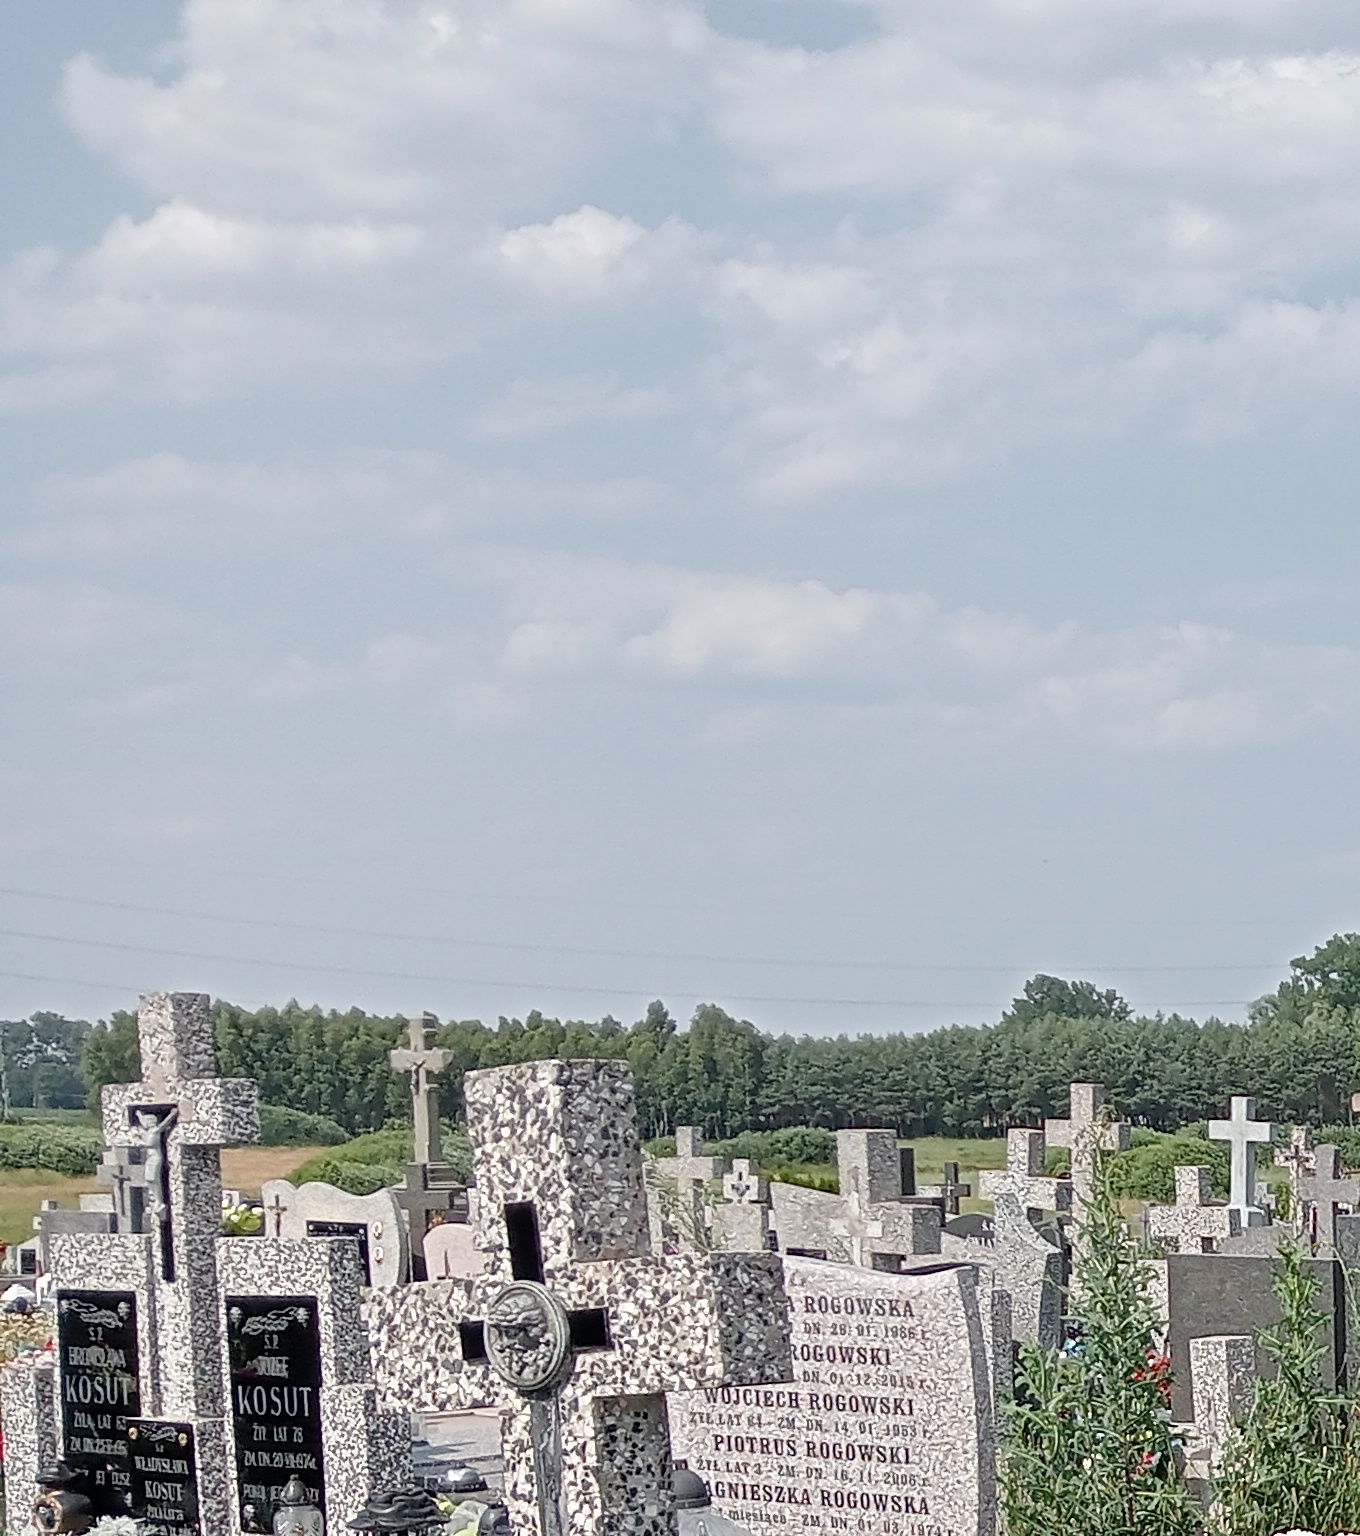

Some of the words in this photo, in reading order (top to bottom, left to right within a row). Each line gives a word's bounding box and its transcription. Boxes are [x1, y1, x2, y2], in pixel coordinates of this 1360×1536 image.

[804, 1295, 915, 1317] ROGOWSKA
[791, 1343, 893, 1366] ROGOWSKI
[65, 1374, 132, 1405] KOSUT
[237, 1385, 312, 1417] KOSUT
[703, 1387, 800, 1409] WOJCIECH
[807, 1392, 915, 1416] ROGOWSKI
[713, 1433, 798, 1458] PIOTRUŚ
[804, 1440, 912, 1465] ROGOWSKI
[820, 1488, 931, 1515] ROGOWSKA
